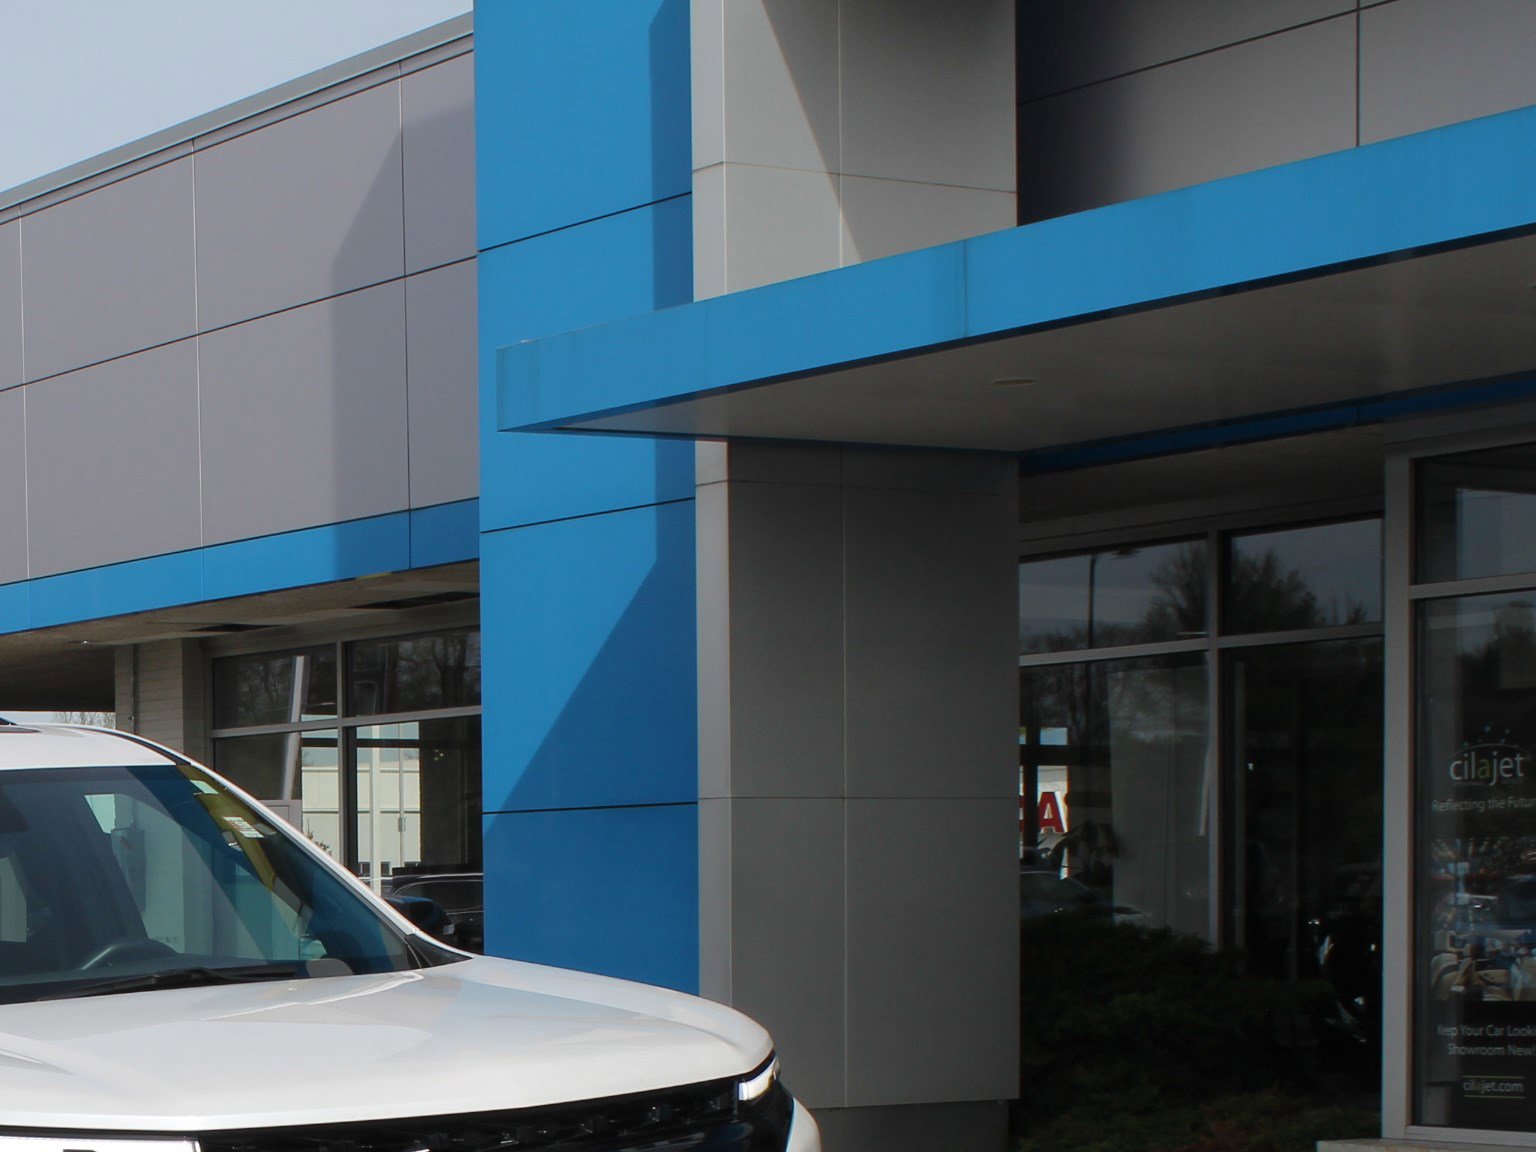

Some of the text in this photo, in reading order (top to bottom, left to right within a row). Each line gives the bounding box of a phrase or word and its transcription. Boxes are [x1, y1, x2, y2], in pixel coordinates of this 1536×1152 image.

[1449, 751, 1525, 786] cilajet
[1488, 797, 1505, 809] the
[1460, 1024, 1484, 1037] Your
[1486, 1024, 1505, 1037] Car
[1447, 1043, 1505, 1056] Showroom
